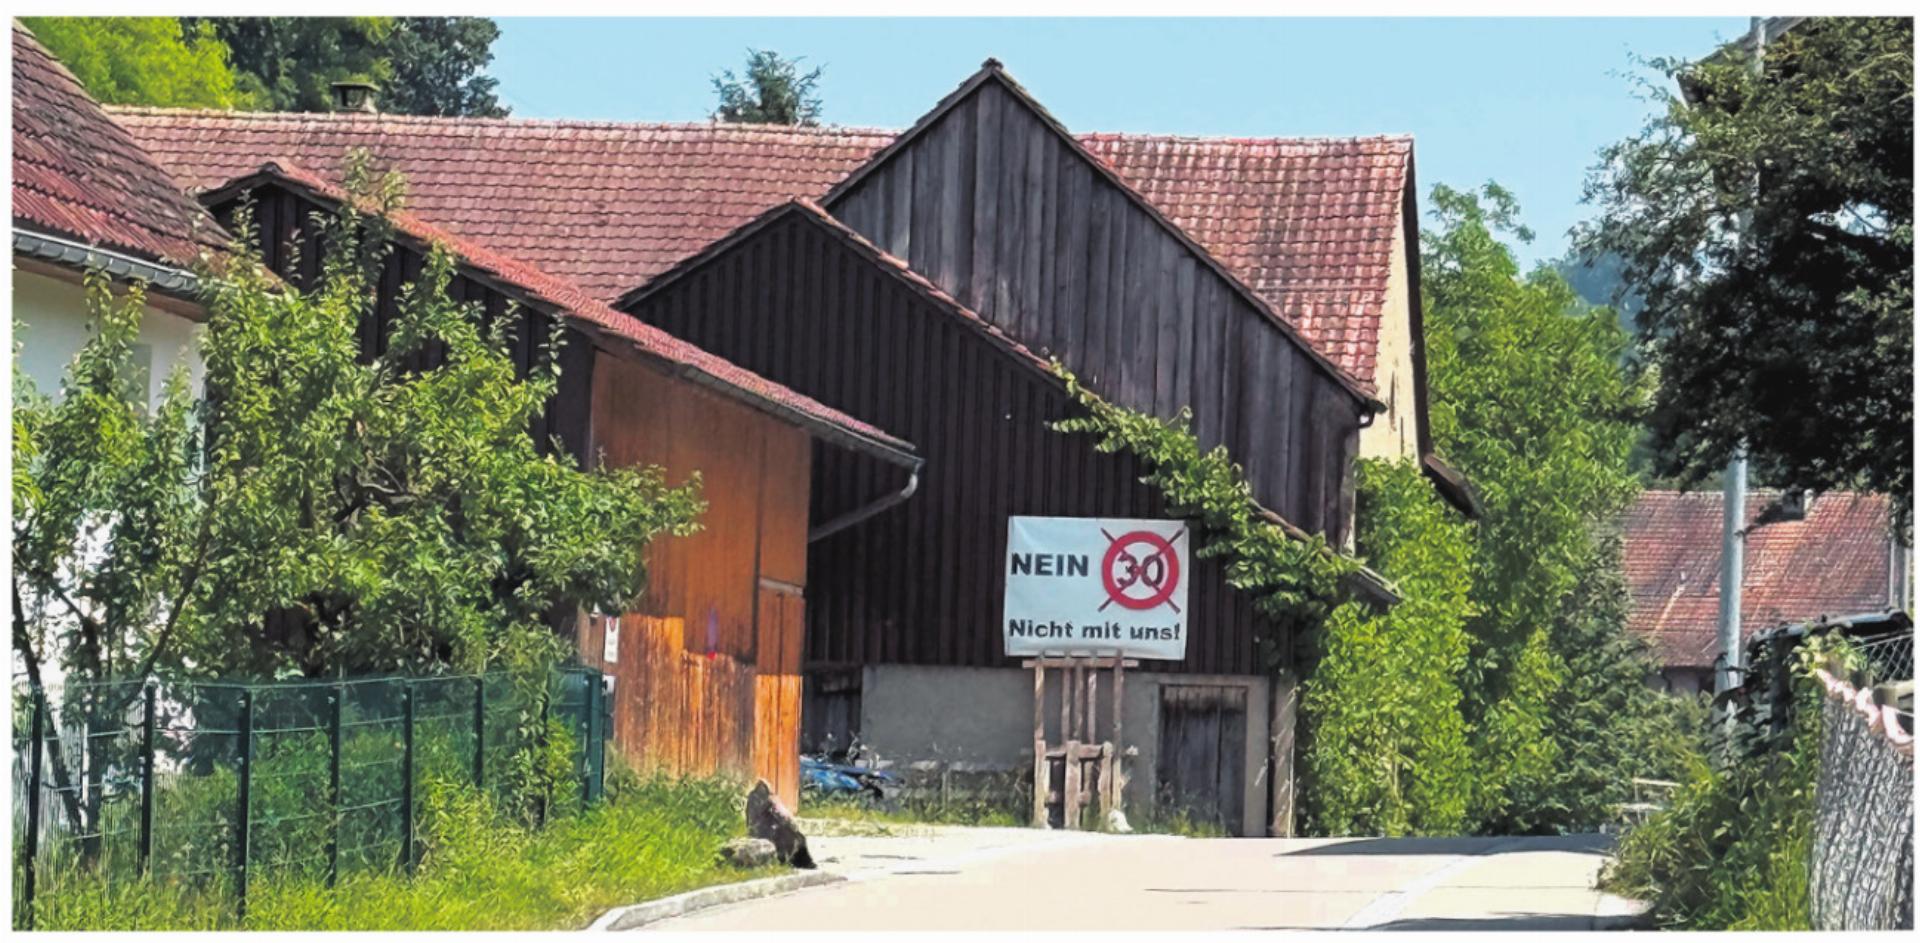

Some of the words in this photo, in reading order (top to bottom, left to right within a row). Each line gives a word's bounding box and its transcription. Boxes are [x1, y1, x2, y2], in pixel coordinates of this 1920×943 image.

[1010, 553, 1089, 577] NEIN
[1116, 554, 1164, 588] 30
[1009, 619, 1074, 639] Nicht
[1082, 621, 1121, 640] mit
[1129, 623, 1181, 641] uns!
